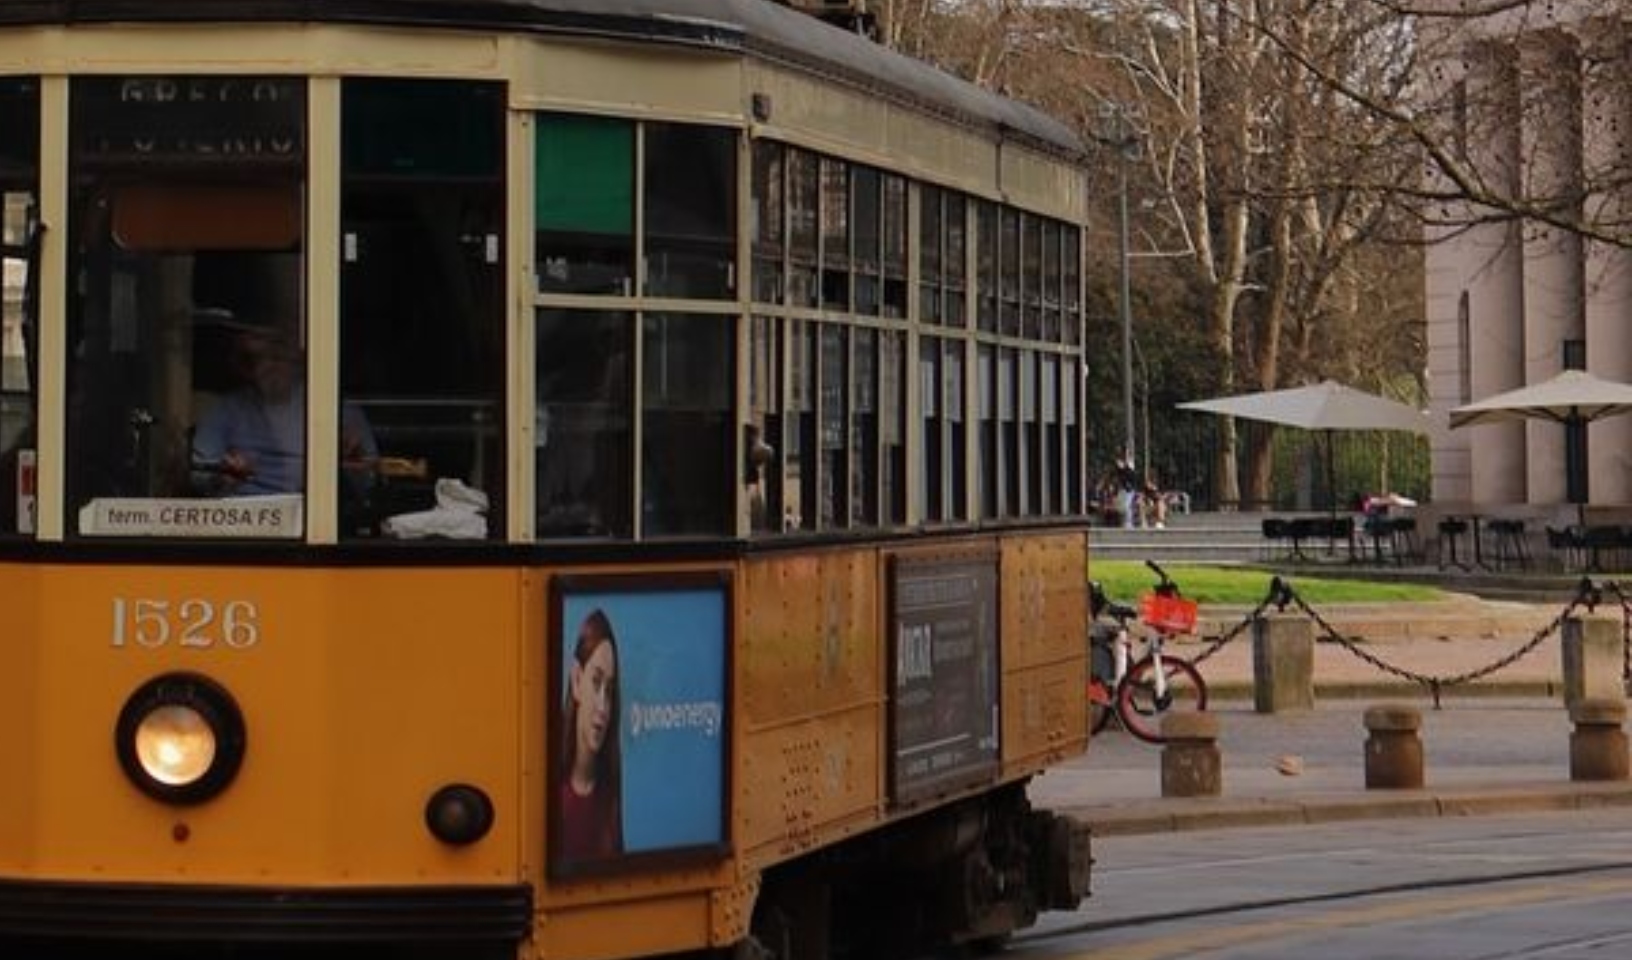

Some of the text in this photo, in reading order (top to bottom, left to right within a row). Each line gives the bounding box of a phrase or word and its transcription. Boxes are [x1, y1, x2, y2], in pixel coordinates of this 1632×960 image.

[108, 506, 282, 526] term. CERTOSA FS
[110, 596, 260, 648] 1526
